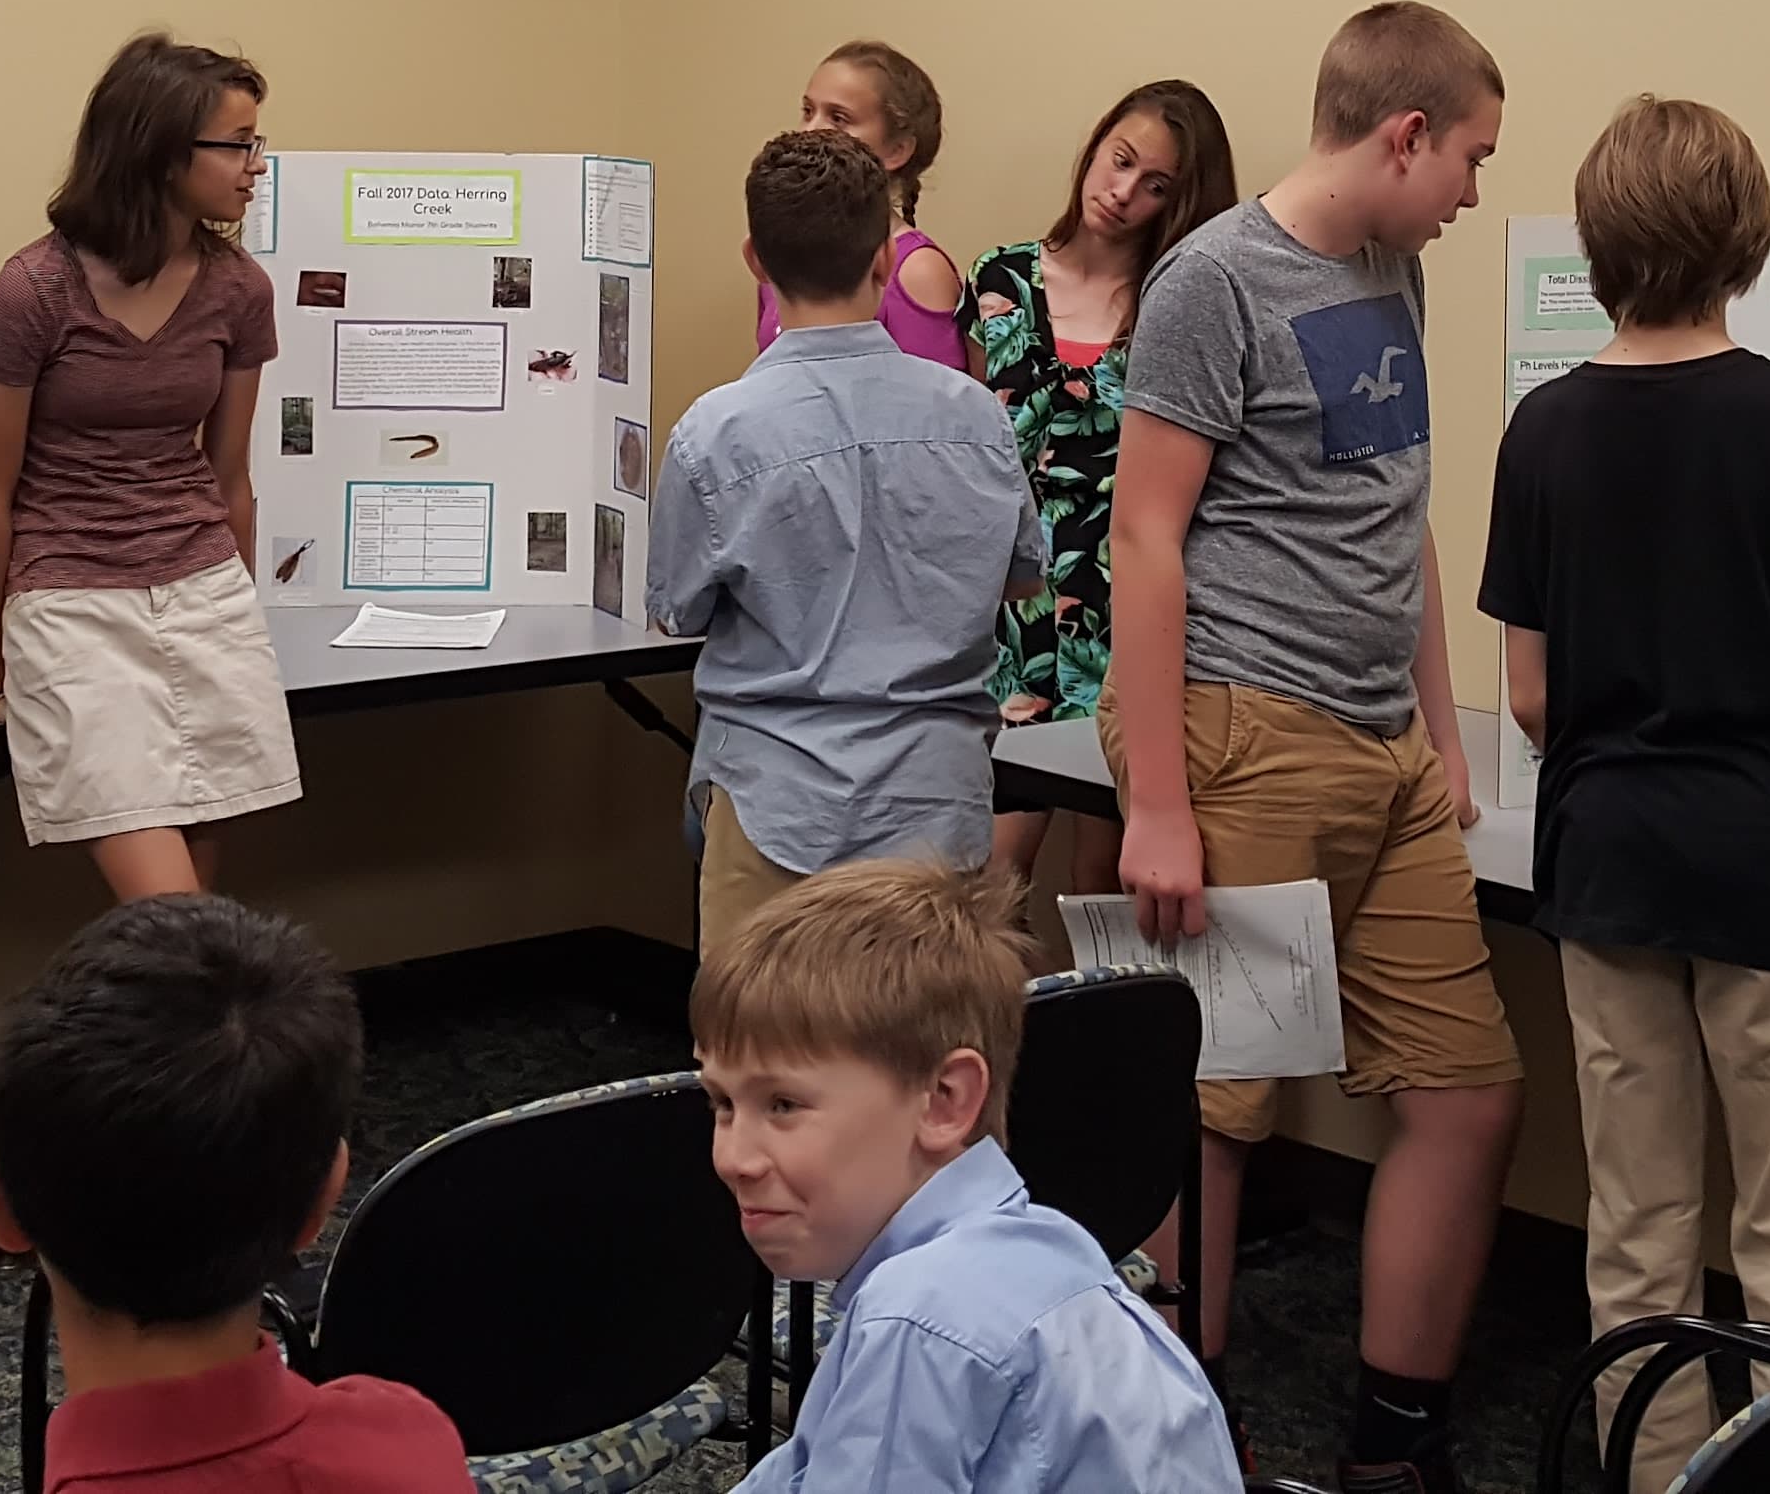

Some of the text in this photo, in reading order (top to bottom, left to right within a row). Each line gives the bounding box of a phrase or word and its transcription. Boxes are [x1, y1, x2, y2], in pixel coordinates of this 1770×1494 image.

[358, 187, 383, 199] Fall
[386, 187, 413, 200] 2017
[456, 188, 508, 203] Herring
[413, 202, 453, 215] Creek
[1548, 274, 1567, 285] Total
[368, 327, 473, 337] Overall Stream Health
[1520, 360, 1531, 370] Ph
[1533, 360, 1559, 370] Levels
[1329, 445, 1374, 461] HOLLISTER
